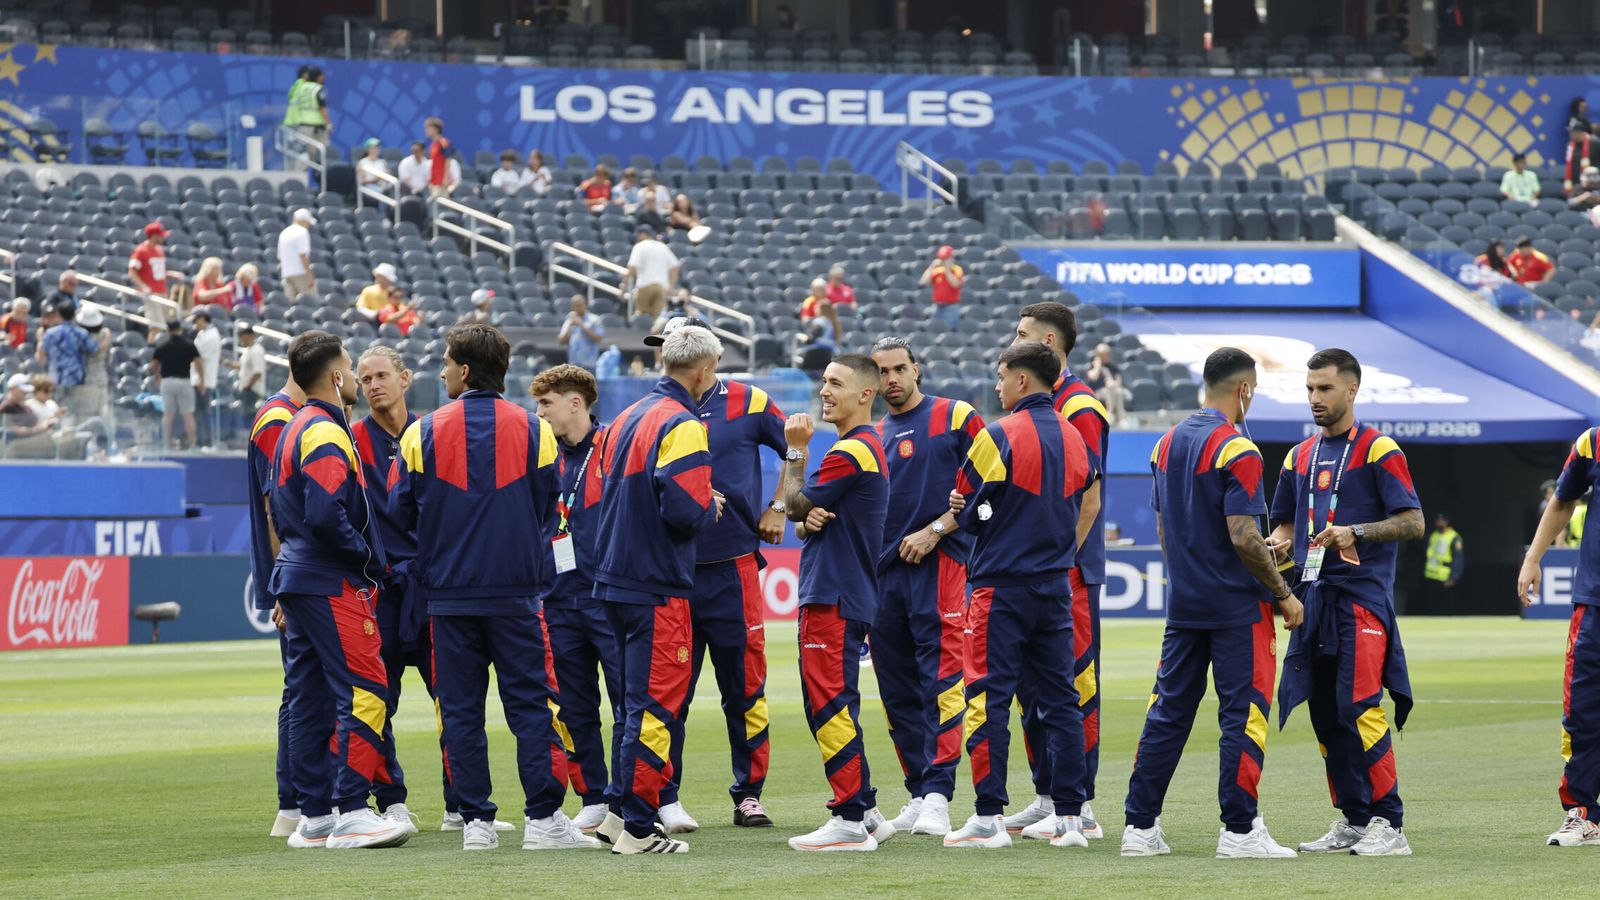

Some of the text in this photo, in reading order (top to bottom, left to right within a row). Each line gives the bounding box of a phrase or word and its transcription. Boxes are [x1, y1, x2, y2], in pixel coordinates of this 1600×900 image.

[519, 85, 994, 127] LOS ANGELES
[1056, 261, 1312, 285] FIFA WORLD CUP 2026
[1395, 423, 1425, 437] CUP
[1426, 422, 1481, 437] 2026
[95, 520, 162, 556] FIFA
[8, 559, 105, 645] Coca-Cola
